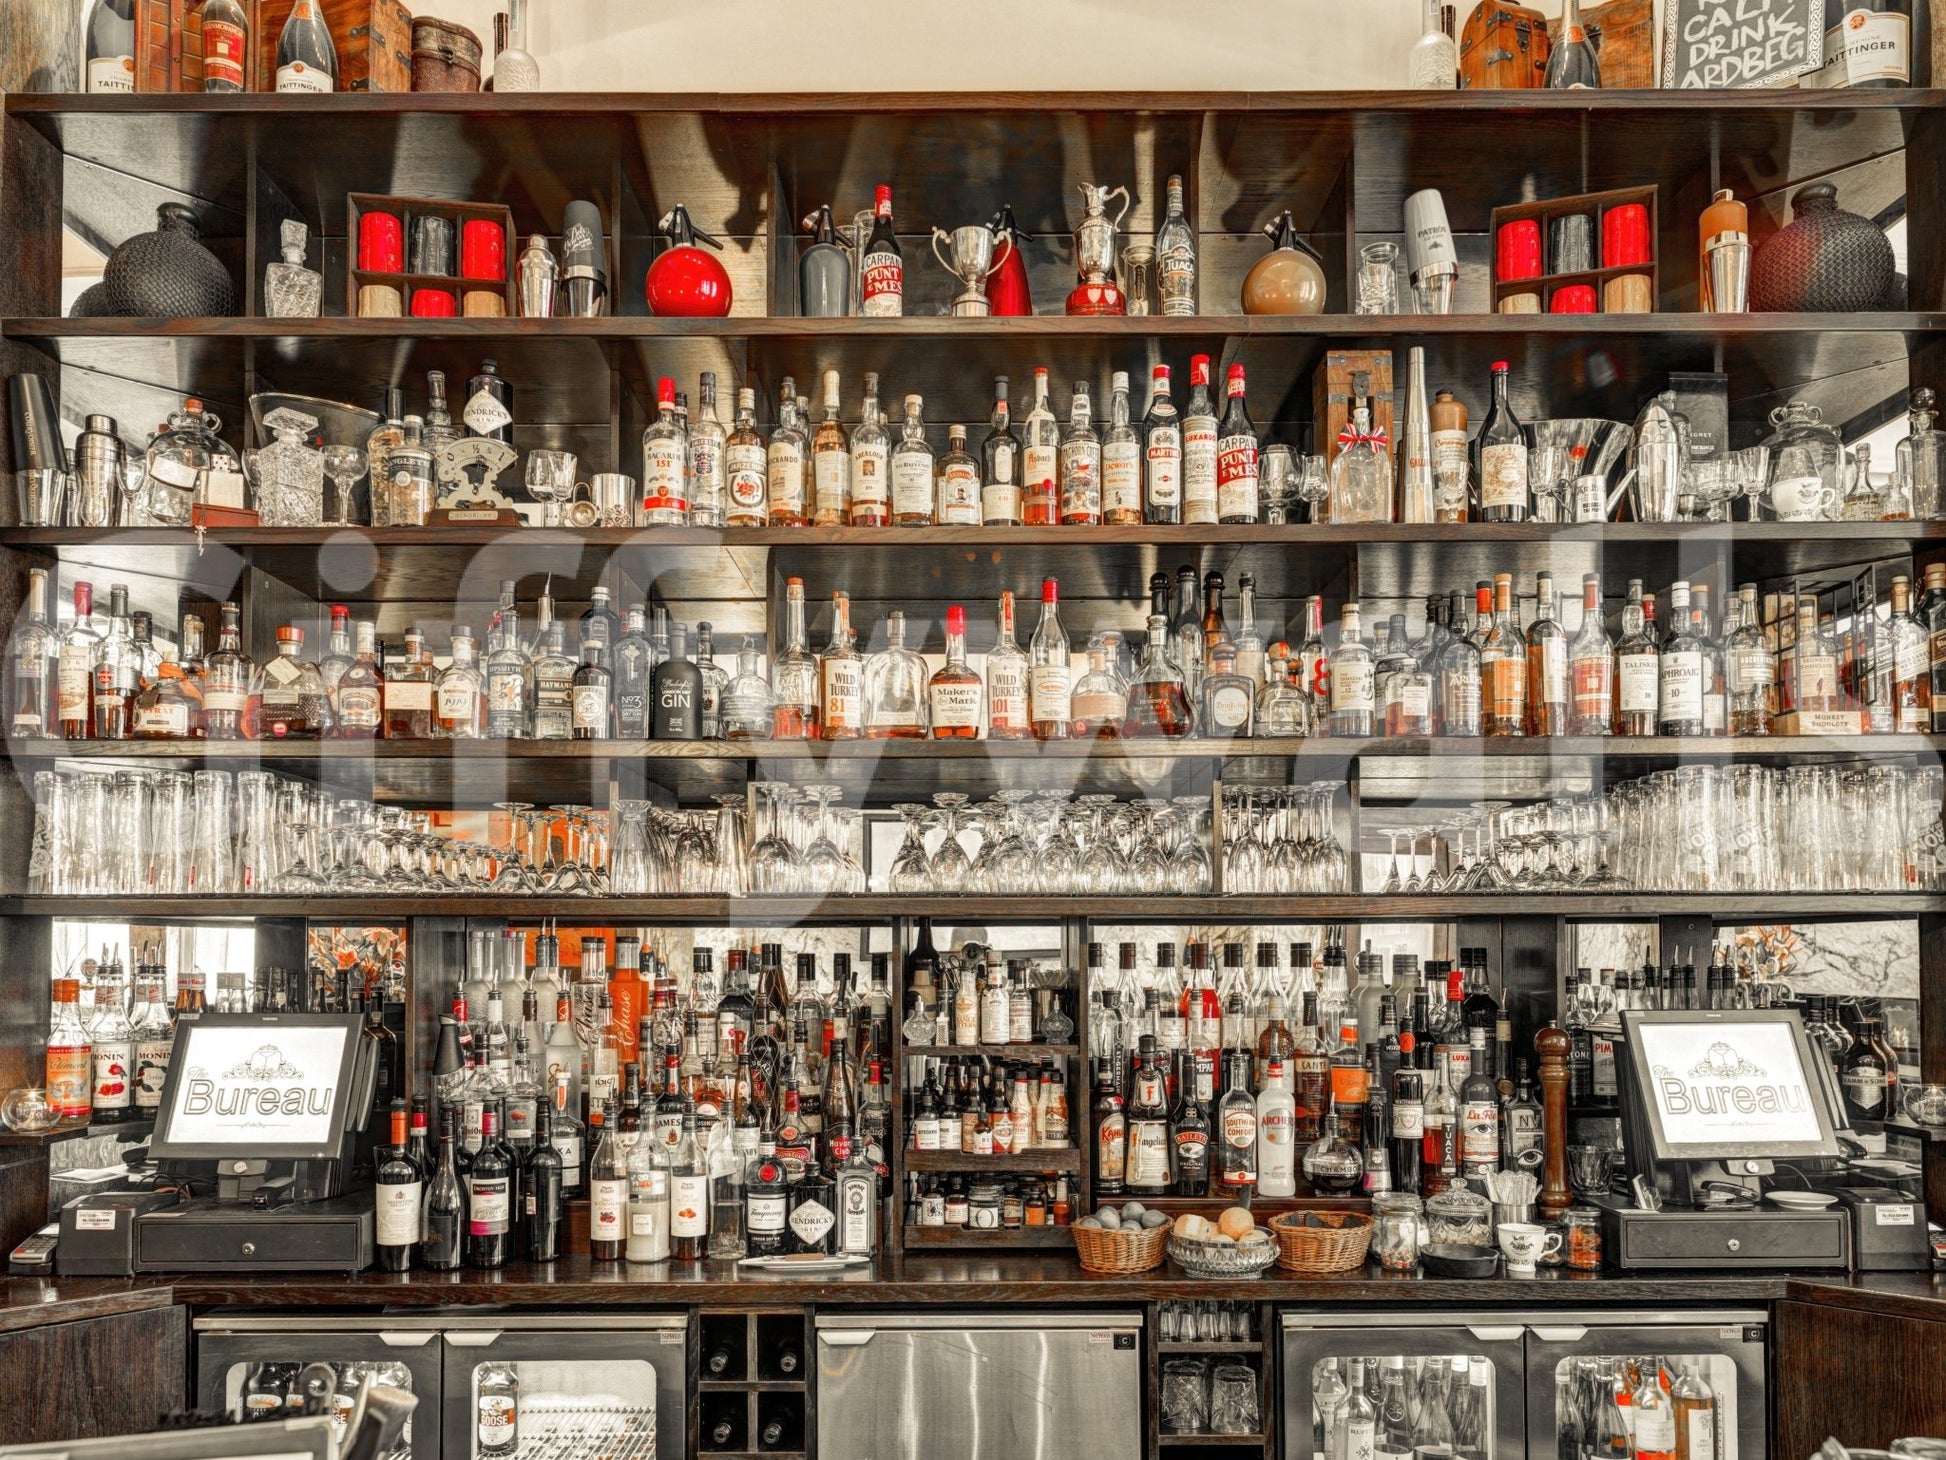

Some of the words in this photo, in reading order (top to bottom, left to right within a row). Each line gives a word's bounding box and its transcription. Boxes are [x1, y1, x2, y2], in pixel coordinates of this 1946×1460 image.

[1690, 4, 1799, 68] DRINK
[1679, 25, 1806, 88] ARDBEG
[1822, 41, 1896, 70] TAITTINGER
[279, 83, 324, 93] TAITTINGER
[1168, 259, 1194, 271] TUACA
[866, 267, 900, 283] PUNT
[647, 452, 681, 461] BACARDI
[855, 451, 884, 461] ABERLOUR
[1221, 451, 1255, 468] PUNT
[655, 460, 672, 468] 151
[834, 669, 857, 681] WILD
[995, 674, 1017, 685] WILD
[830, 680, 858, 697] TURKEY
[937, 688, 977, 696] Maker's
[992, 685, 1024, 698] TURKEY
[1670, 688, 1681, 698] 10
[661, 695, 691, 708] GIN
[830, 698, 845, 712] 81
[949, 697, 977, 705] Mark
[992, 699, 1008, 713] 101
[620, 990, 636, 1047] Chase
[183, 1078, 333, 1116] Bureau
[1659, 1077, 1807, 1115] Bureau
[1226, 1119, 1255, 1128] SOUTHERN
[1262, 1115, 1295, 1126] ARCHERS
[1175, 1132, 1208, 1145] BAILEYS
[1227, 1128, 1254, 1138] COMFORT
[1445, 1123, 1453, 1162] TUACA
[750, 1207, 783, 1218] Tanqueray
[791, 1216, 834, 1225] HENDRICK'S
[480, 1415, 508, 1427] GOOSE
